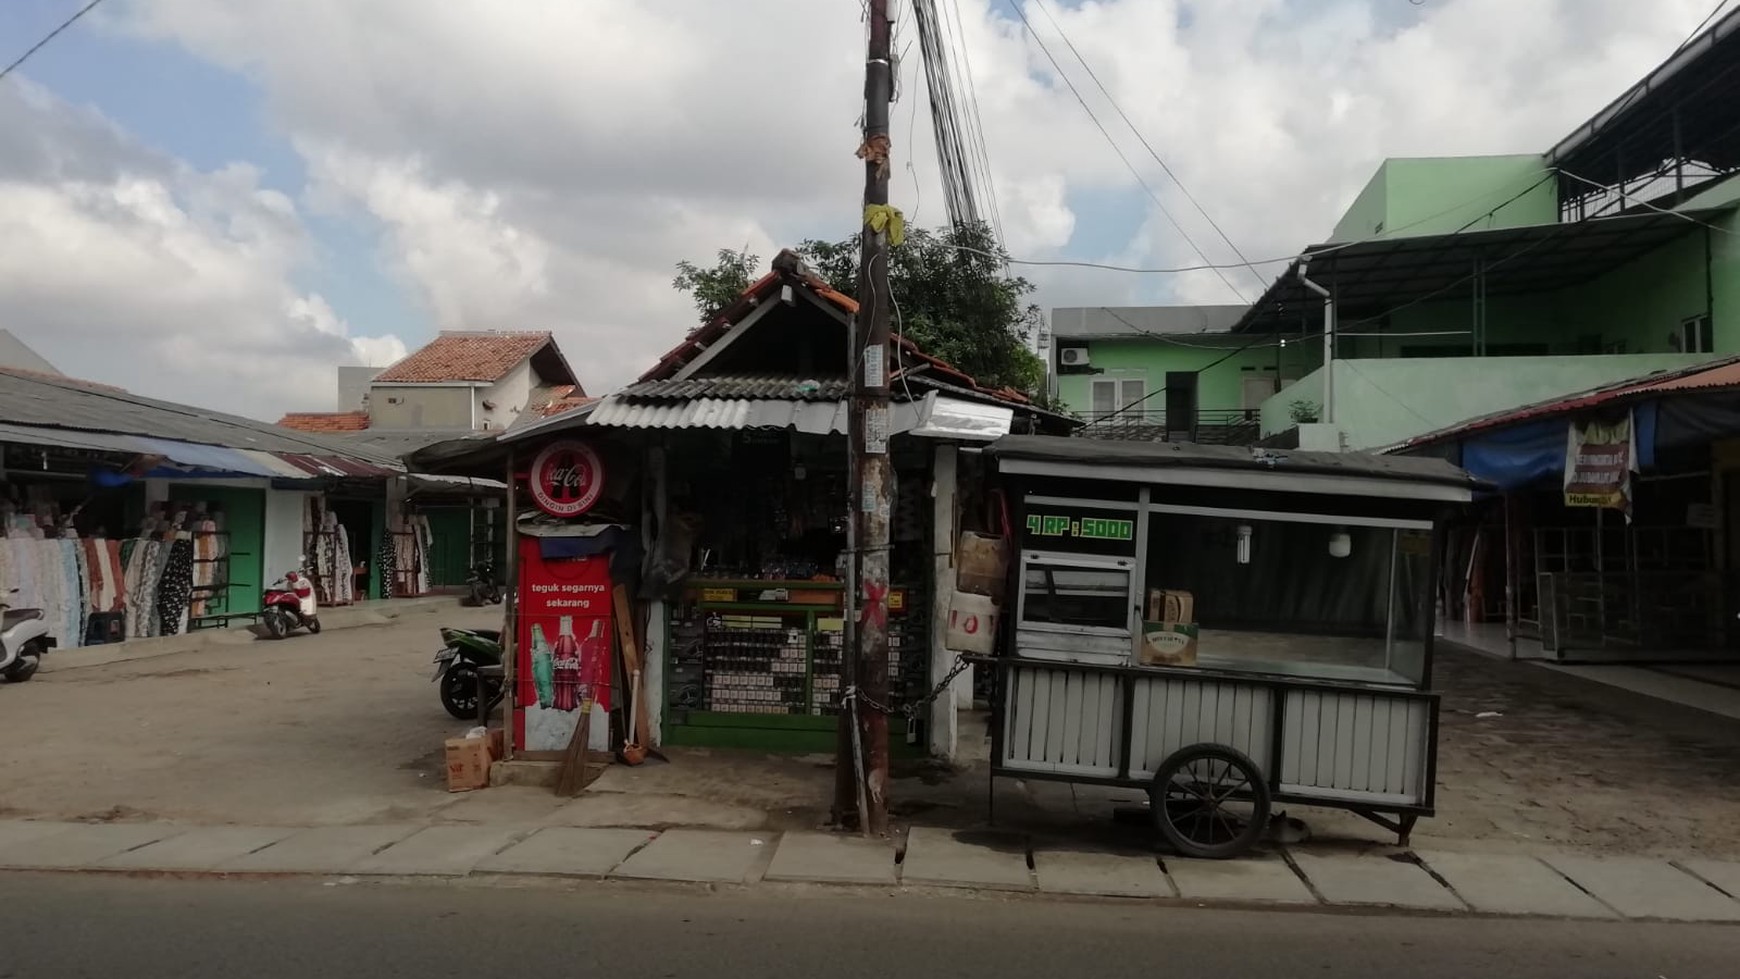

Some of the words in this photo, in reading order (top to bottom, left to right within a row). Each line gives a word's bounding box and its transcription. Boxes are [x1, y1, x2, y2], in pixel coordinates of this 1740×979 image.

[537, 492, 564, 511] DINGIN
[531, 583, 559, 593] teguk
[561, 584, 605, 593] segarnya
[546, 598, 590, 608] sekarang
